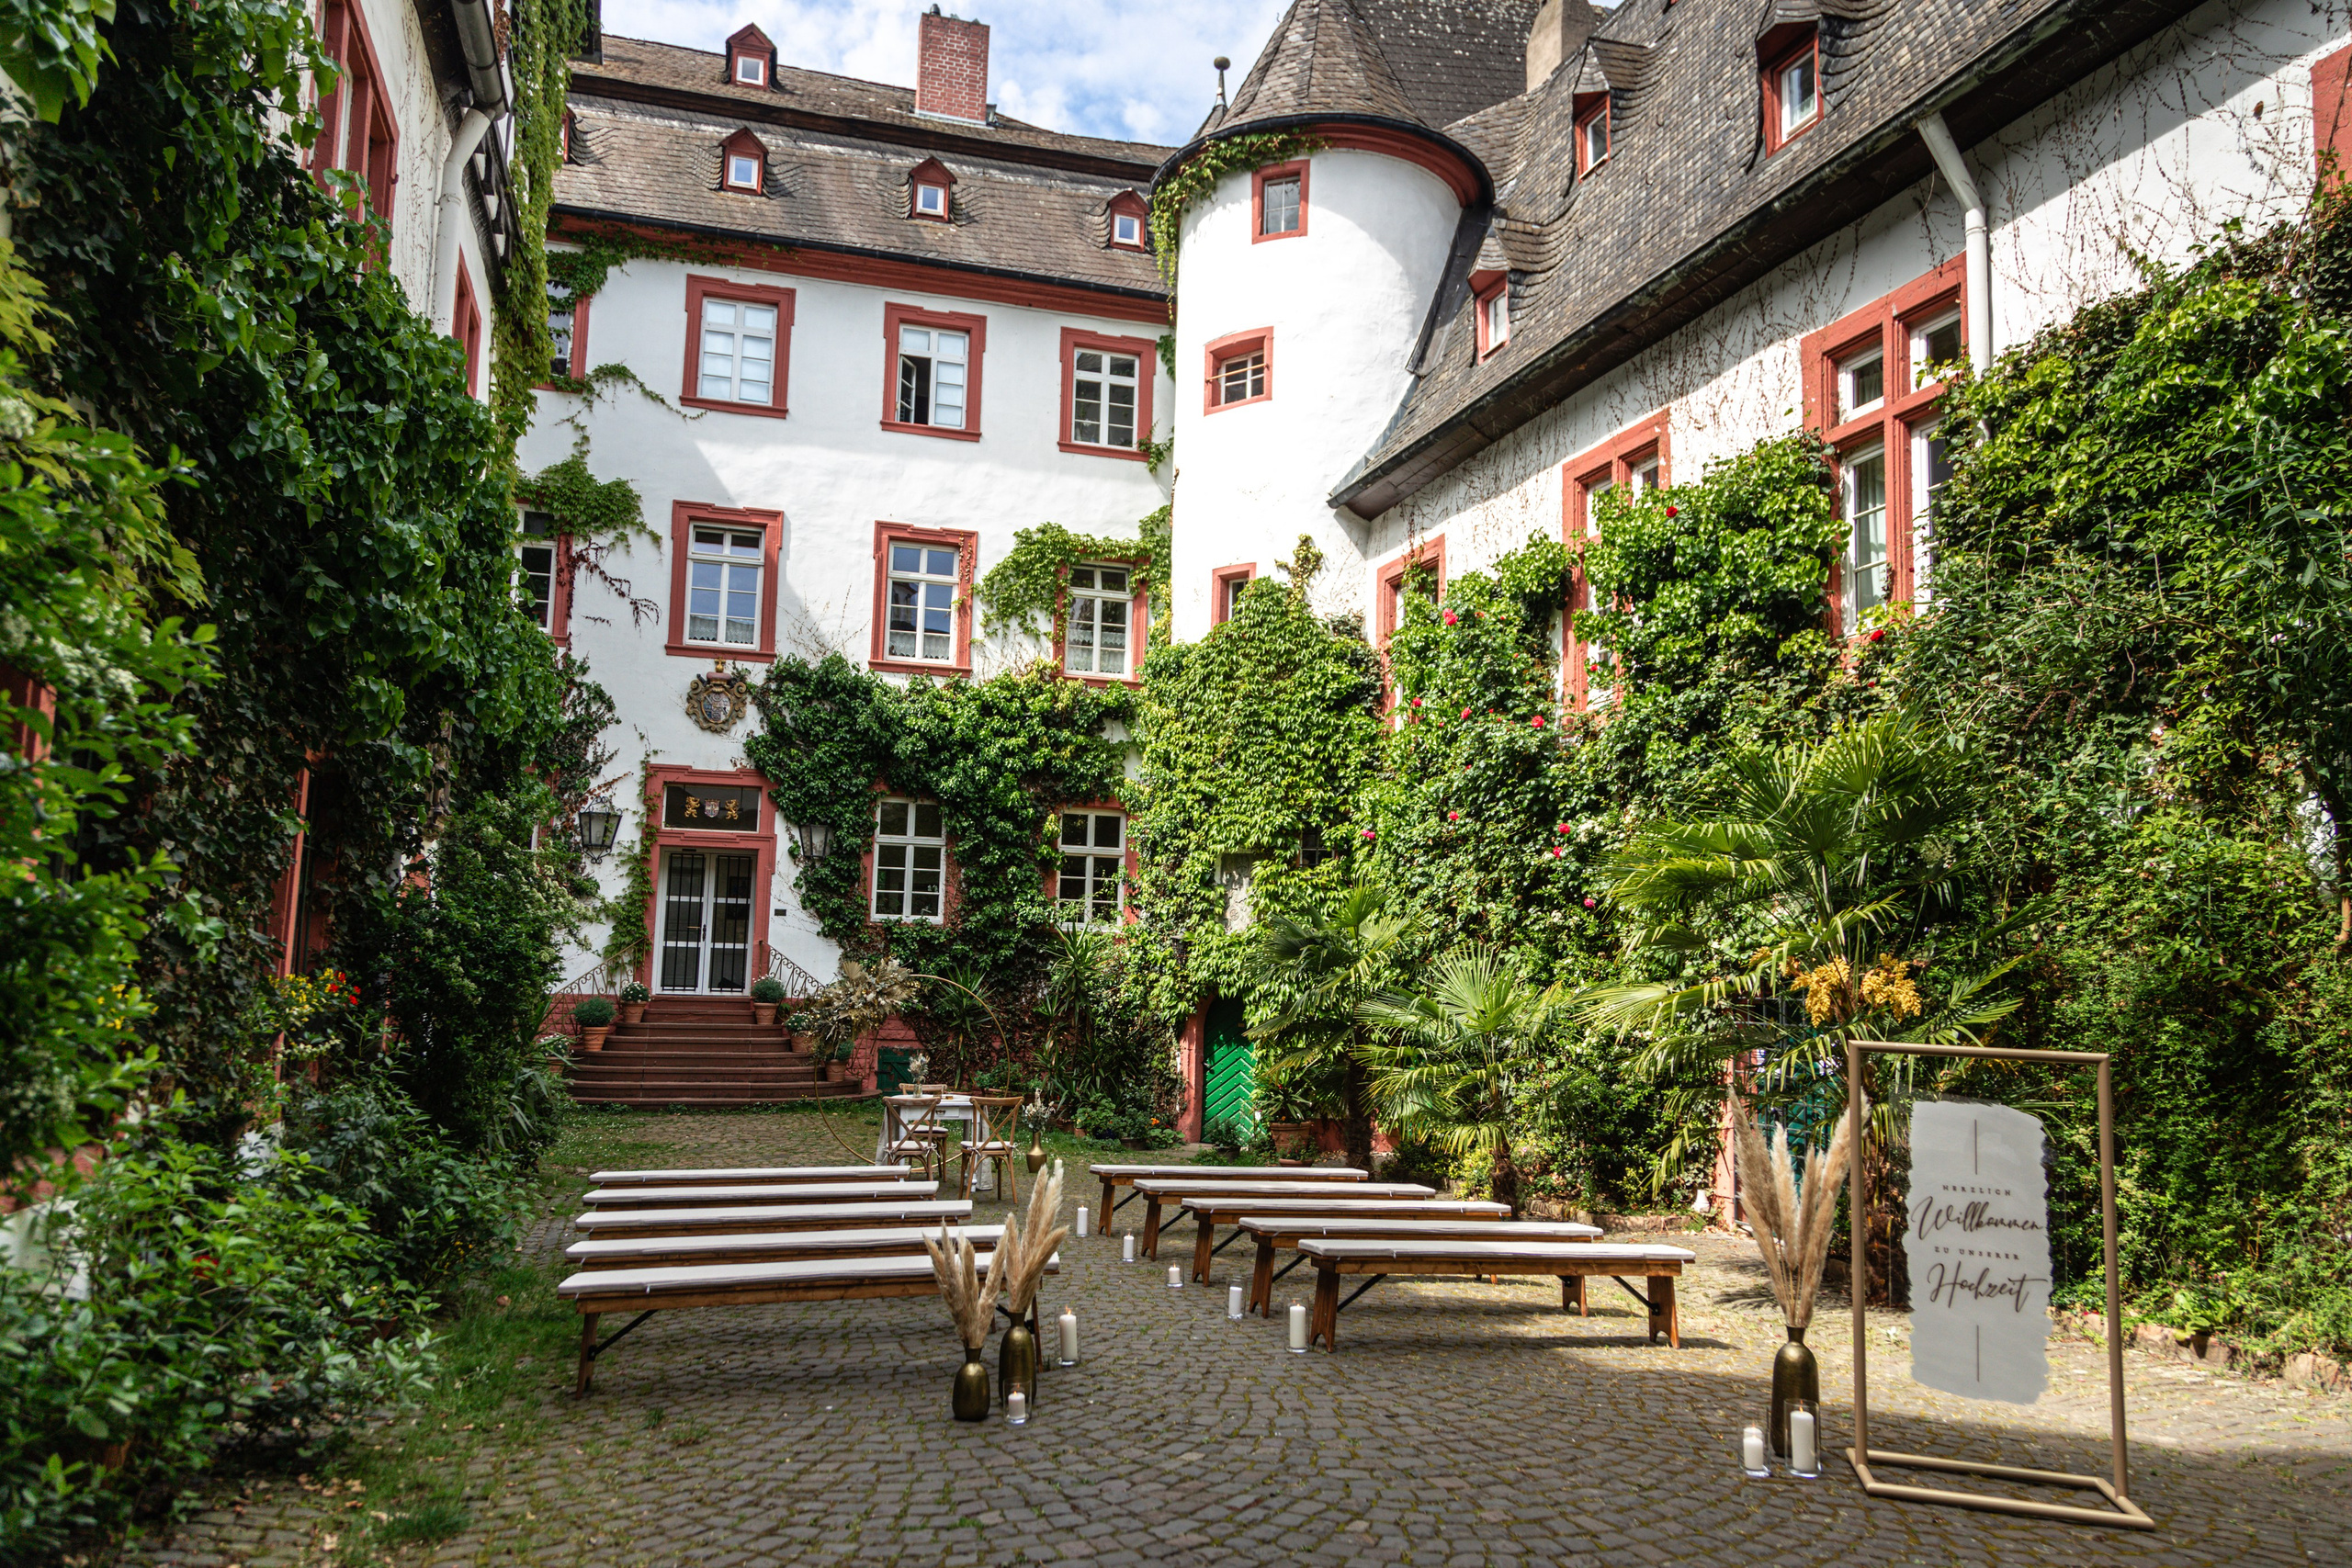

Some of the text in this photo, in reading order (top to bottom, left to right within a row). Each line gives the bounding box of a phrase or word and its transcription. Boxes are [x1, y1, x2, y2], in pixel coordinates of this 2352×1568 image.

[1942, 1184, 2011, 1196] HERZLICH
[1911, 1196, 2043, 1240] Willkommen
[1934, 1246, 2019, 1260] ZU UNSERER
[1928, 1260, 2048, 1313] Hochzeit
